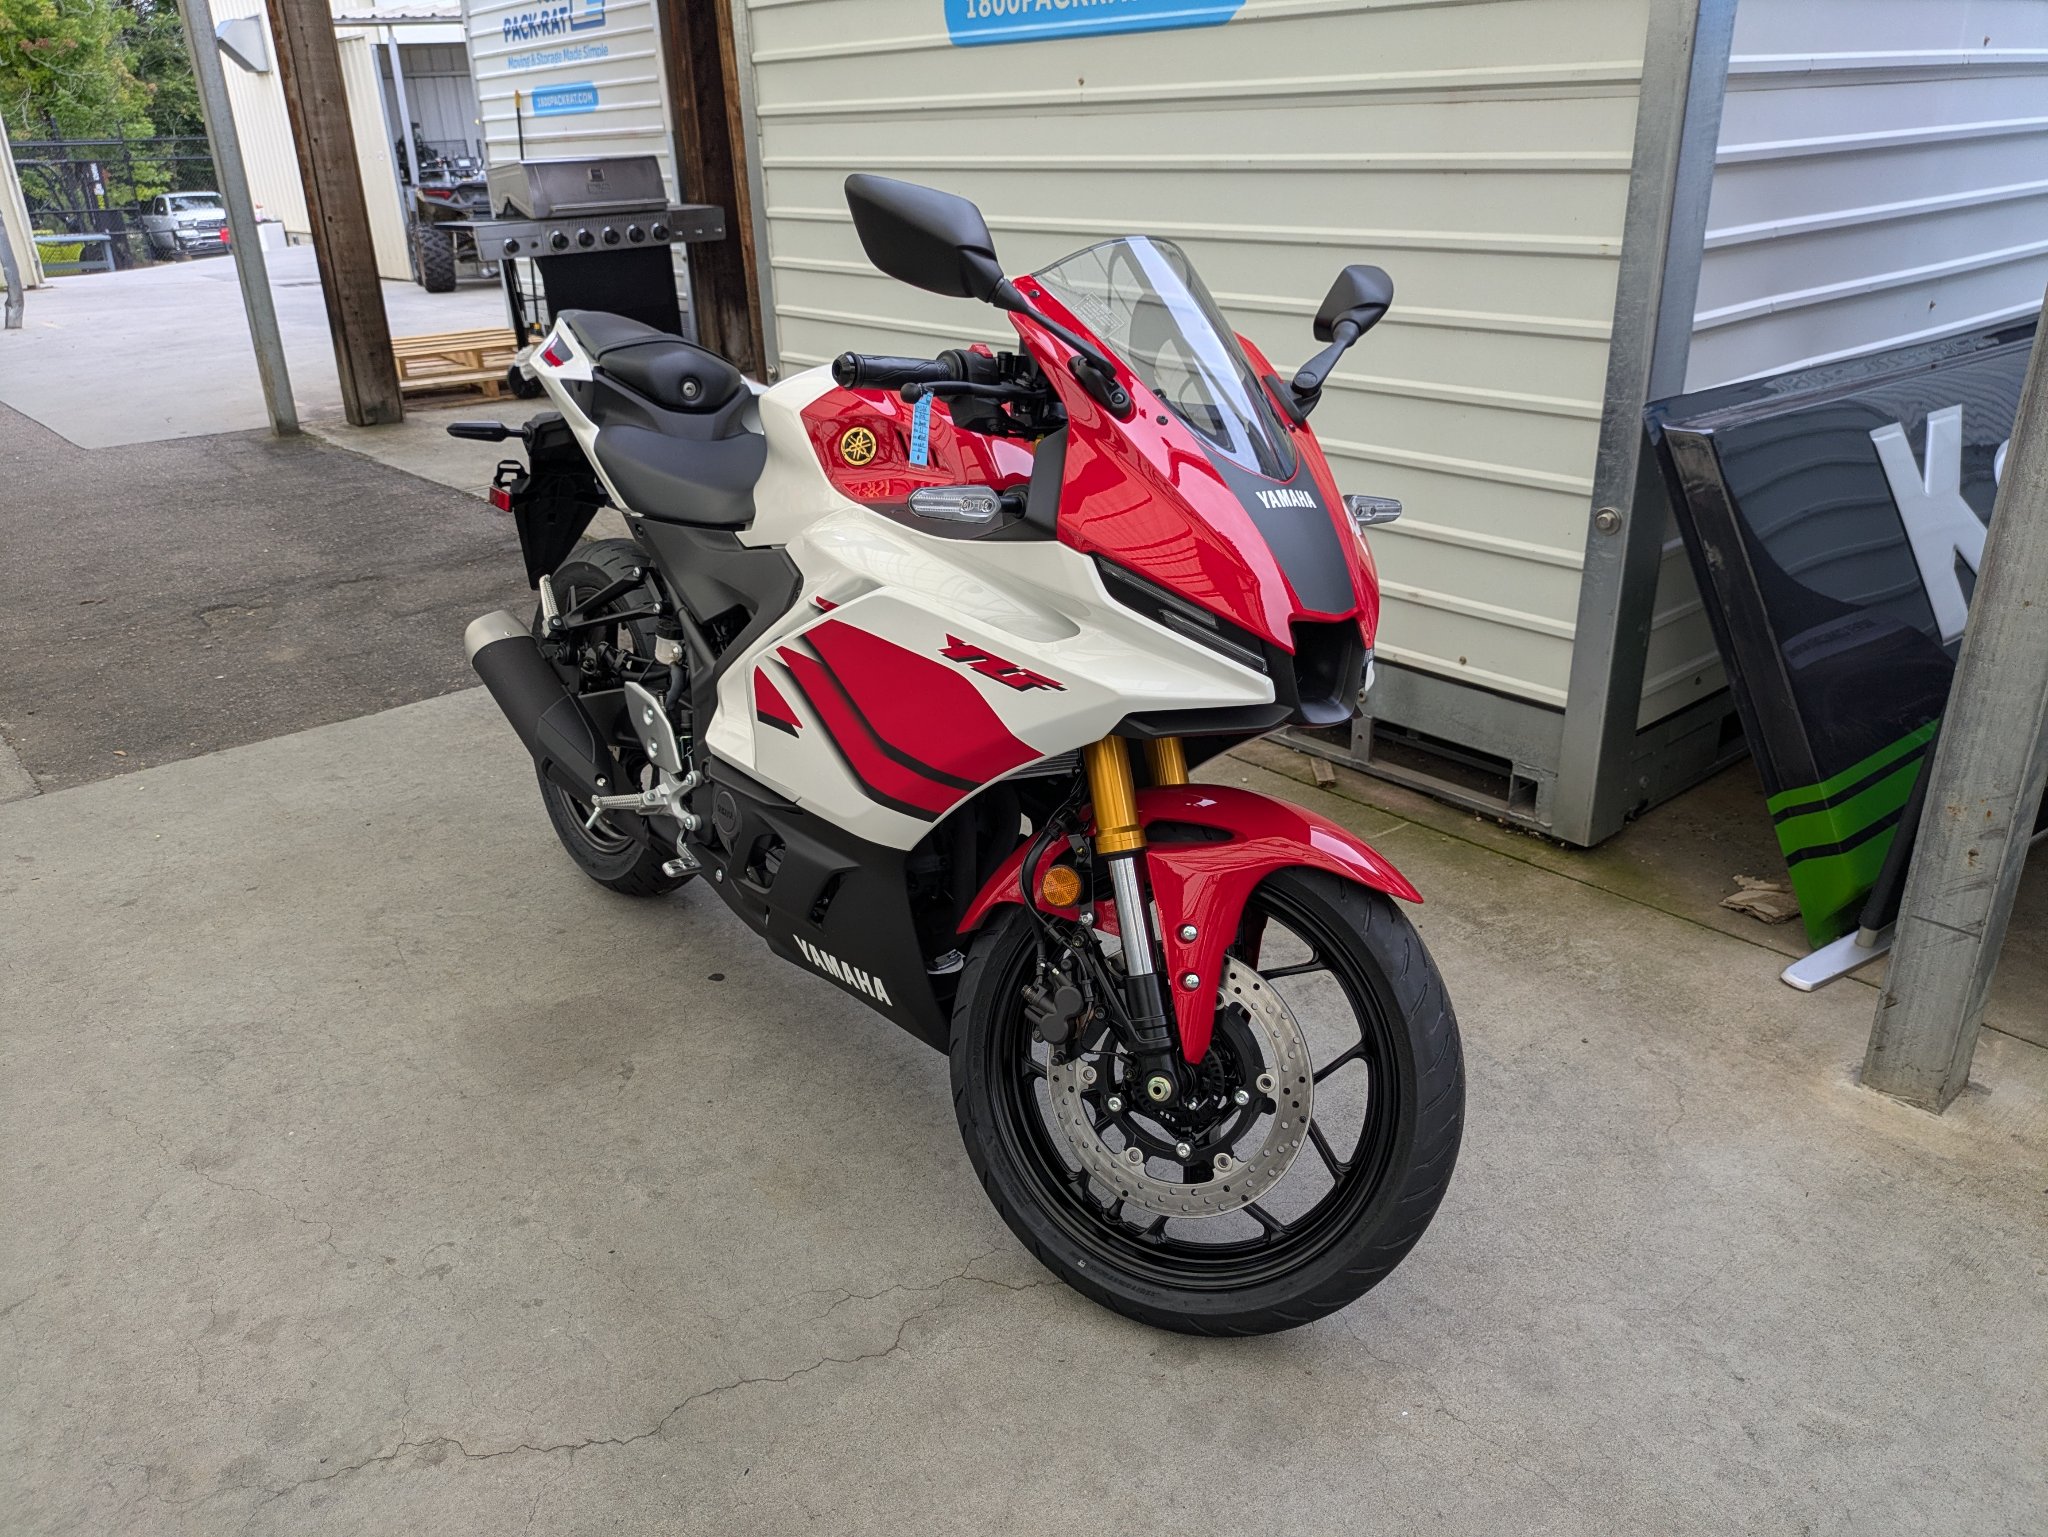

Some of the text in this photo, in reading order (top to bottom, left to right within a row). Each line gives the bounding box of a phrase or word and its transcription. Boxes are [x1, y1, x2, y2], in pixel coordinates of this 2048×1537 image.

[508, 54, 531, 70] Moving
[536, 50, 562, 65] Storage
[563, 47, 582, 61] Made
[583, 43, 609, 58] Simple
[1255, 488, 1318, 509] YAMAHA
[792, 933, 894, 1007] YAMAHA
